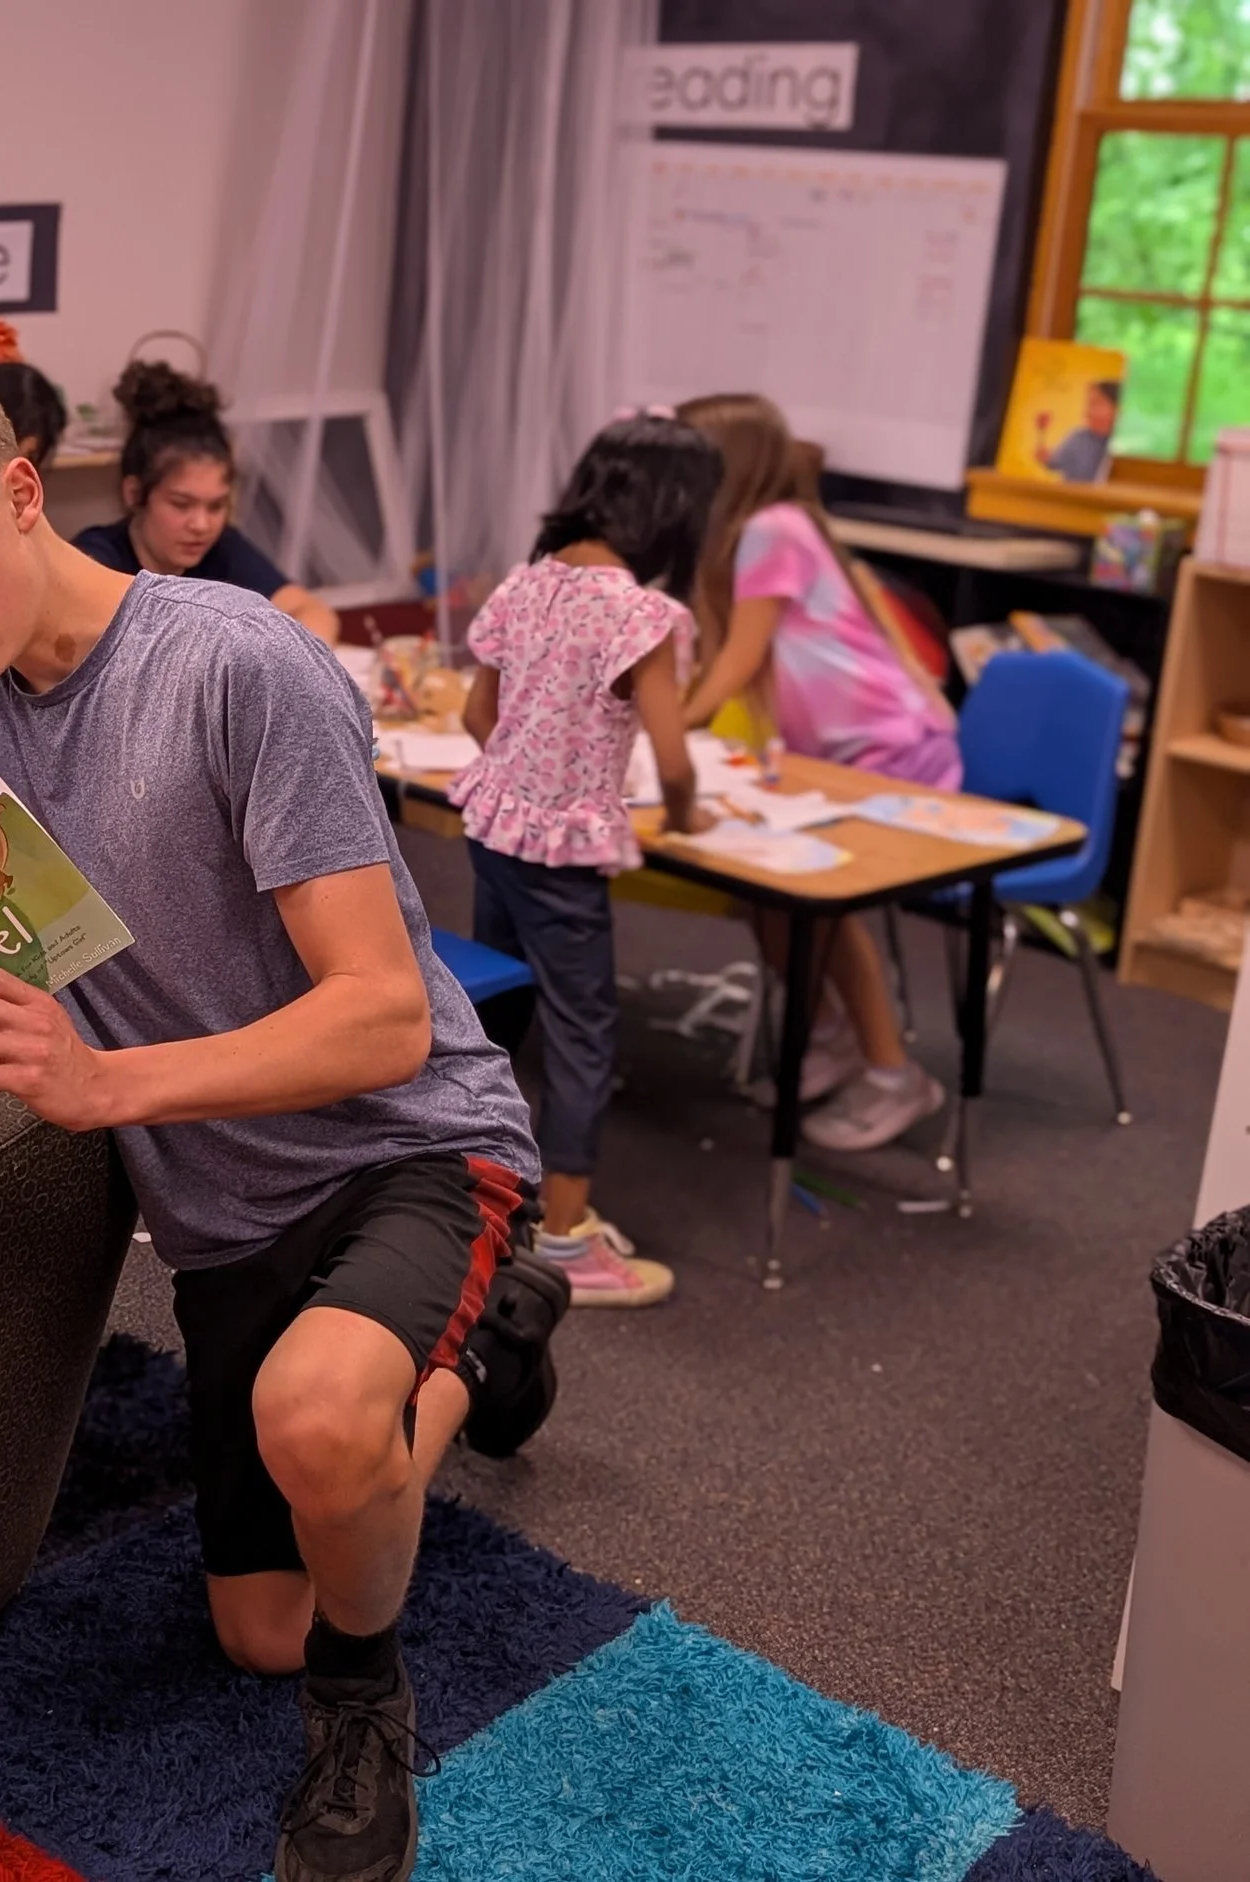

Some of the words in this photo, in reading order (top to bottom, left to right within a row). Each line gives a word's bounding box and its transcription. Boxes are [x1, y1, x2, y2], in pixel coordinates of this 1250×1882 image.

[646, 51, 841, 131] eading
[59, 926, 81, 943] Adults
[44, 960, 84, 988] Michelle
[82, 936, 122, 964] Sullivan
